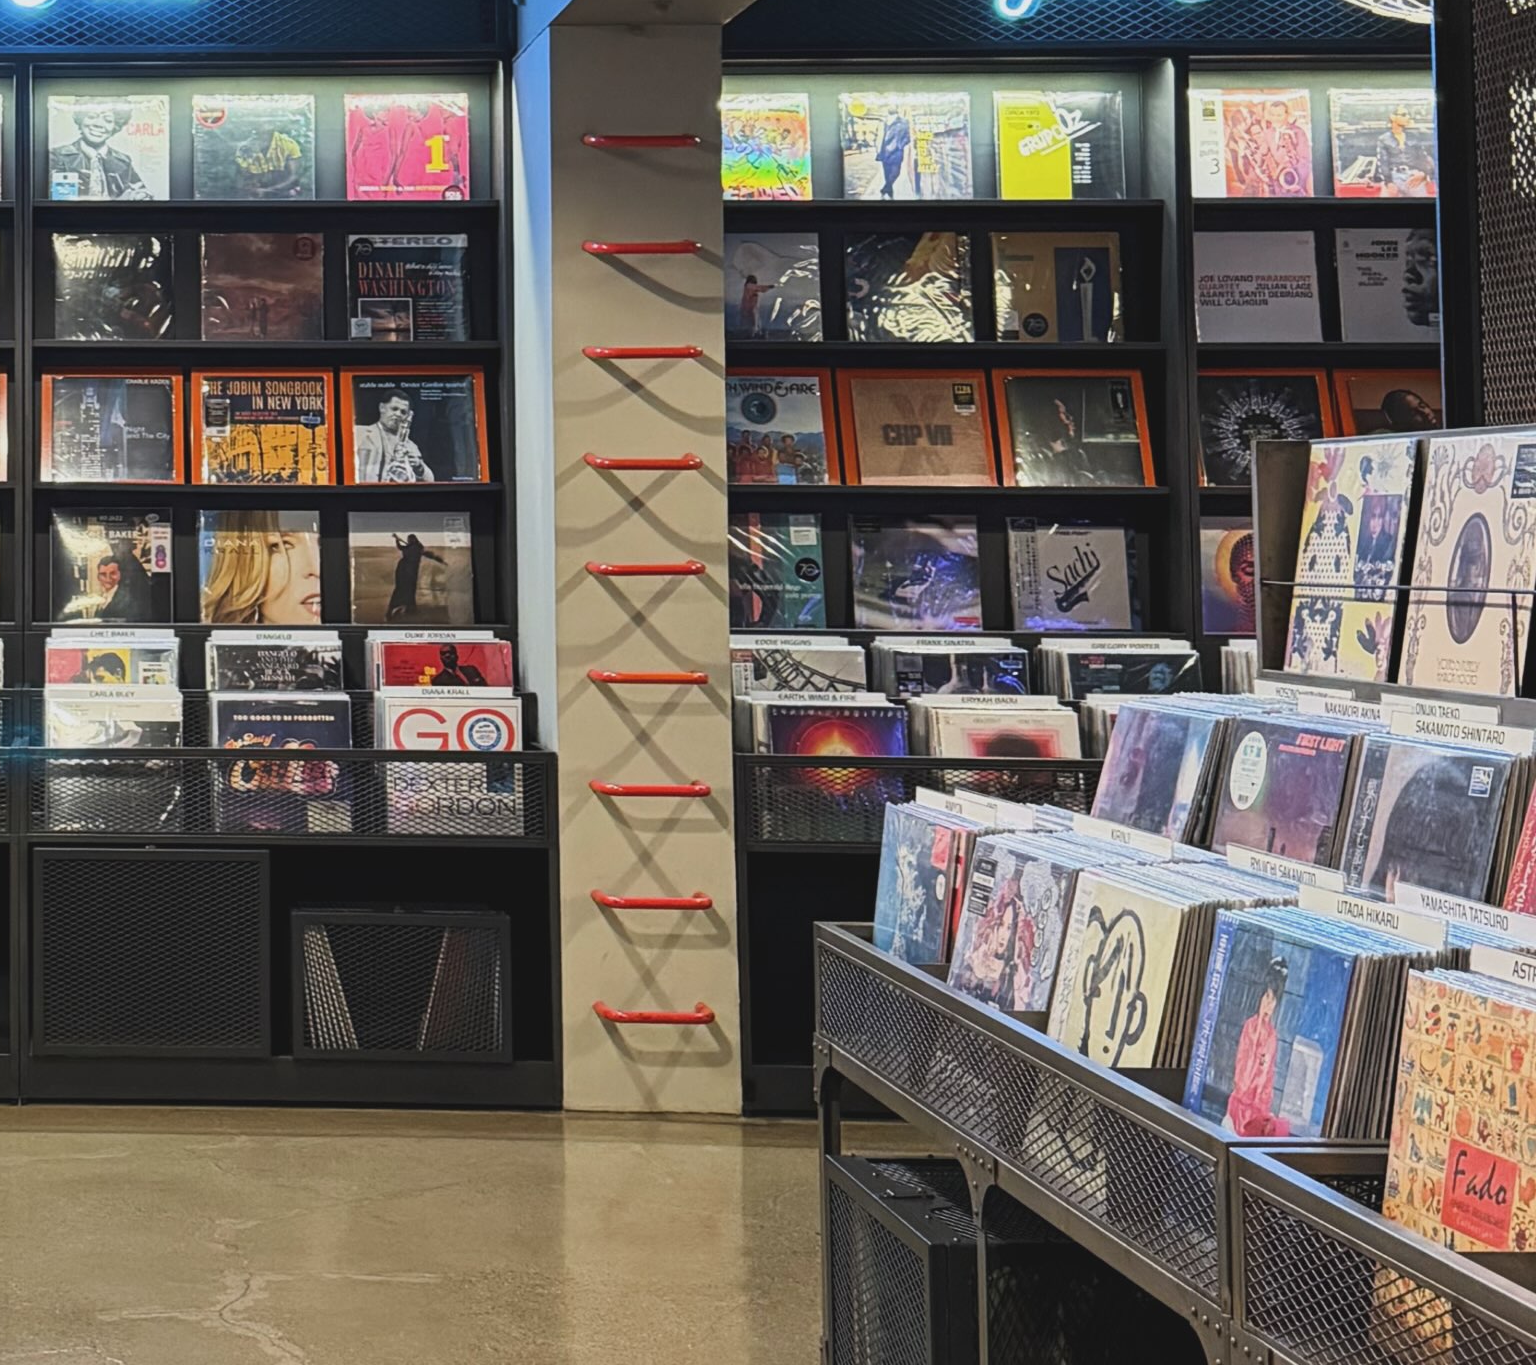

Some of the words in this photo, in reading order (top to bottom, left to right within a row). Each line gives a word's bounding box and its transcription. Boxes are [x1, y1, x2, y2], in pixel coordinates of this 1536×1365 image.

[425, 134, 451, 174] 1
[358, 261, 405, 278] DINAH
[358, 279, 457, 296] WASHINGTON
[1199, 299, 1223, 307] WILL
[226, 380, 262, 396] JOBIM
[265, 380, 323, 396] SONGBOOK
[252, 395, 265, 410] IN
[267, 395, 293, 410] NEW
[295, 395, 324, 410] YORK
[881, 423, 922, 446] CHP
[925, 423, 954, 446] VII
[203, 538, 259, 547] DIANA
[421, 688, 445, 696] DIANA
[446, 688, 470, 696] KRALL
[809, 693, 829, 701] WIND
[1324, 701, 1359, 719] NAKAMORI
[1359, 706, 1382, 721] AKINA
[392, 707, 516, 751] GO
[1415, 719, 1459, 740] SAKAMOTO
[1460, 725, 1506, 745] SHINTARO
[393, 776, 485, 792] DEXTER
[392, 796, 517, 816] GORDON
[1282, 863, 1317, 886] SAKAMOTO
[1335, 897, 1364, 919] UTADA
[1366, 906, 1400, 931] HIKARU
[1419, 893, 1467, 919] YAMASHITA
[1470, 903, 1511, 931] TATSURO
[1450, 1149, 1508, 1207] Fado
